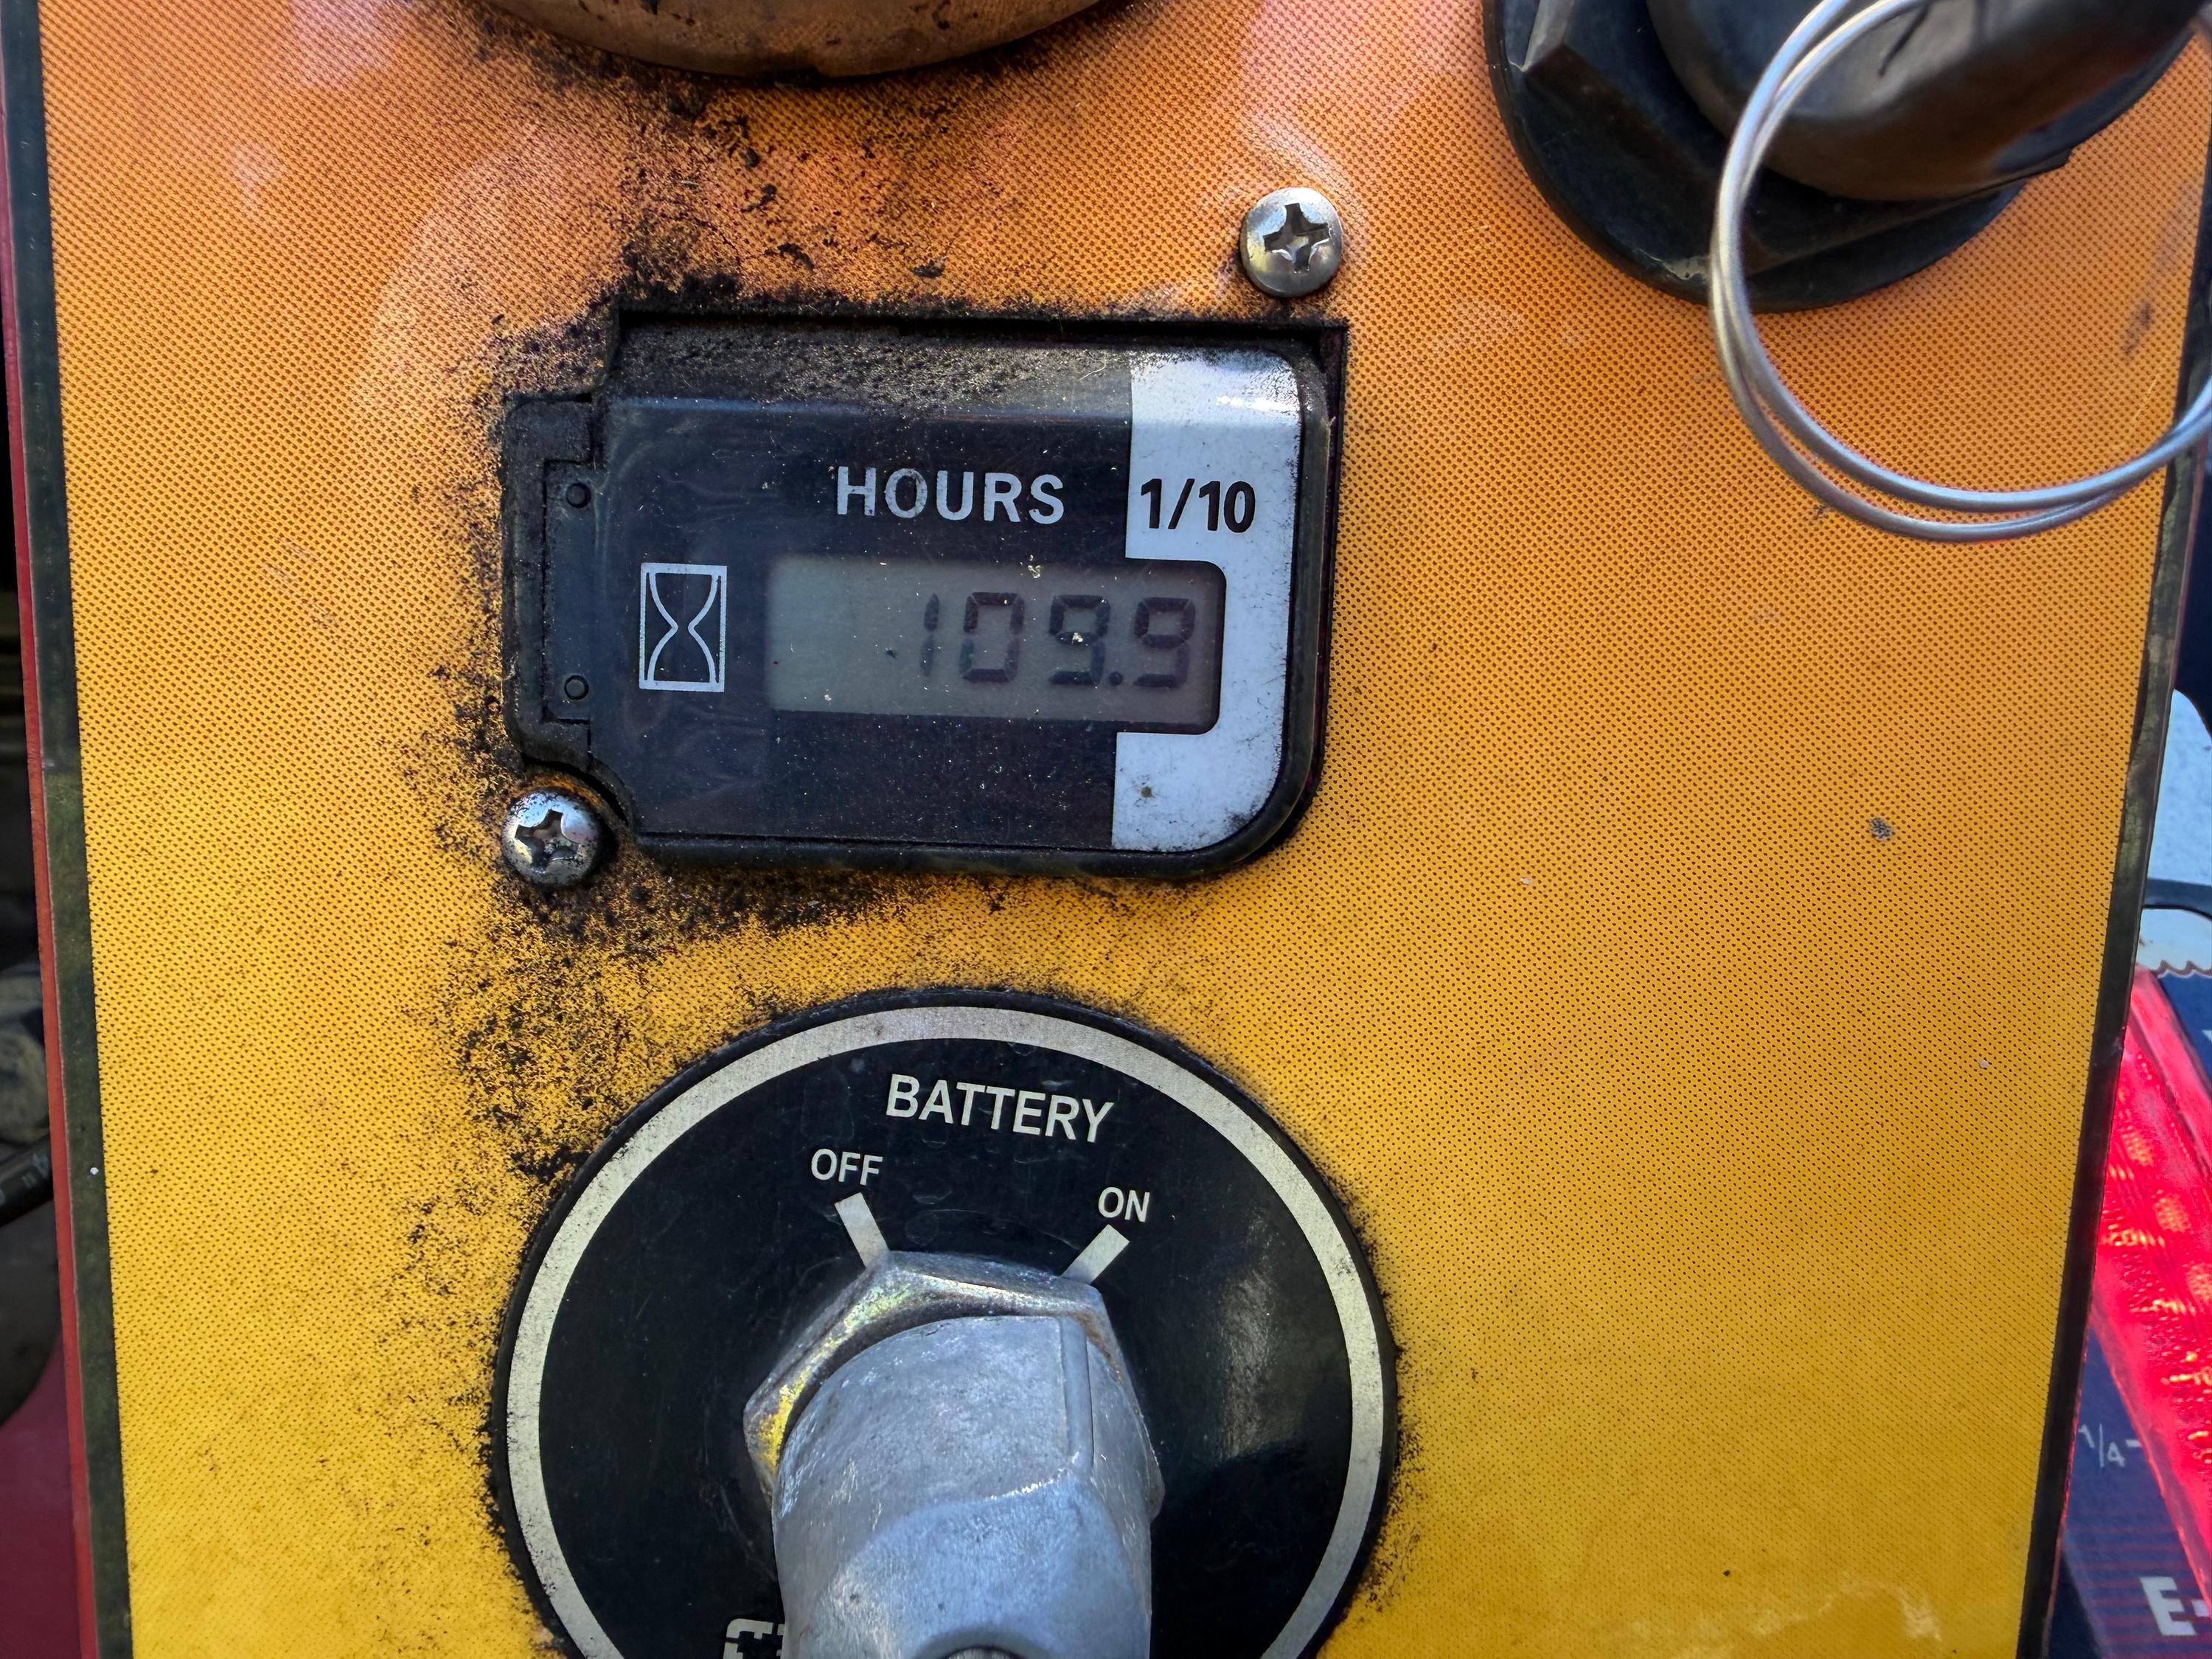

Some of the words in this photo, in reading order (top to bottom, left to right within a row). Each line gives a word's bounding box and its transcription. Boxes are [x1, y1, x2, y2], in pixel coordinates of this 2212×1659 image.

[837, 465, 1064, 524] HOURS
[1140, 477, 1256, 534] 1/10
[919, 591, 1196, 689] 109.9
[885, 1073, 1115, 1144] BATTERY
[810, 1147, 883, 1186] OFF
[1097, 1186, 1150, 1223] ON
